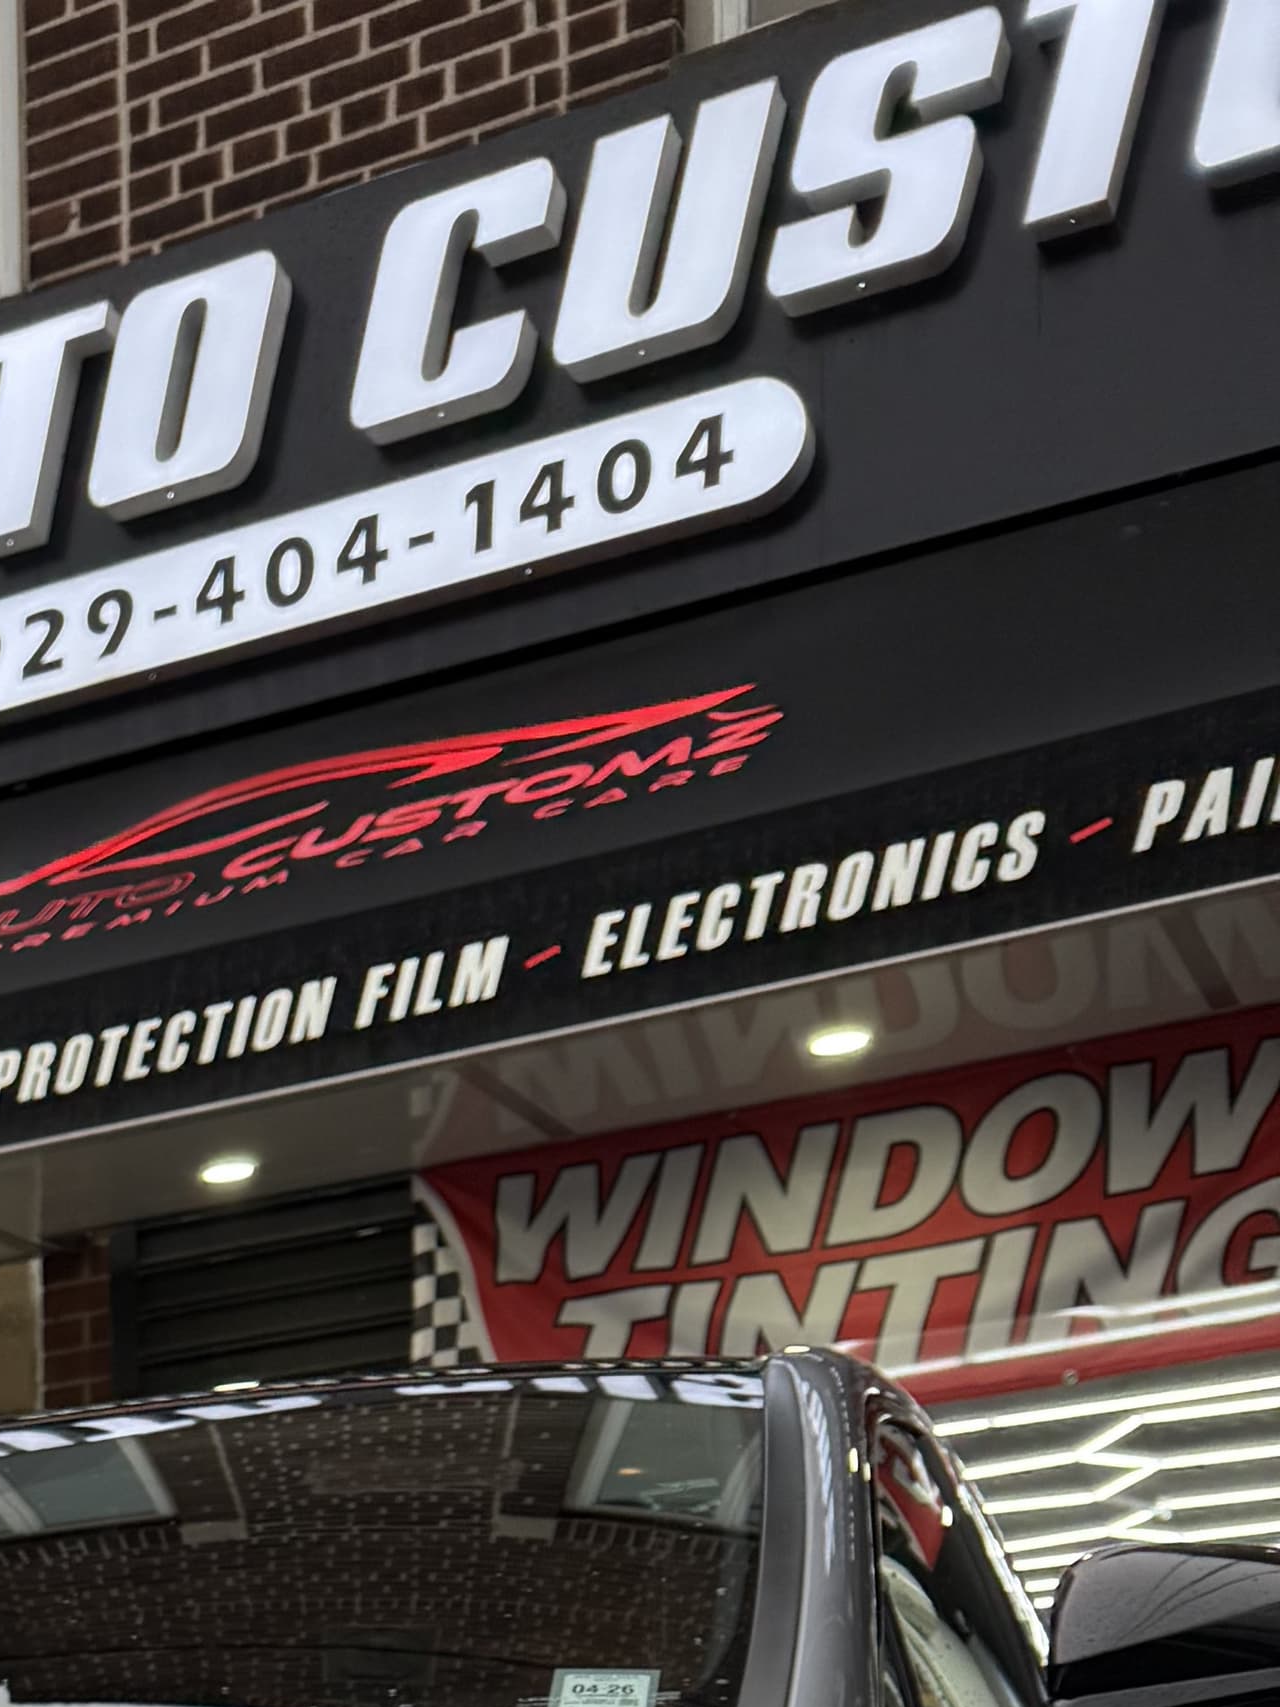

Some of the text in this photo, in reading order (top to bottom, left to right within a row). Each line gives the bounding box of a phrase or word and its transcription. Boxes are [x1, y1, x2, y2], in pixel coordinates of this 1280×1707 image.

[222, 705, 784, 880] CUSTOMZ
[336, 819, 488, 869] CAR
[533, 754, 749, 819] CARE
[354, 935, 511, 1031] FILM
[580, 809, 1048, 980] ELECTRONICS
[1131, 756, 1280, 854] PAI
[496, 1038, 1280, 1285] WINDOW
